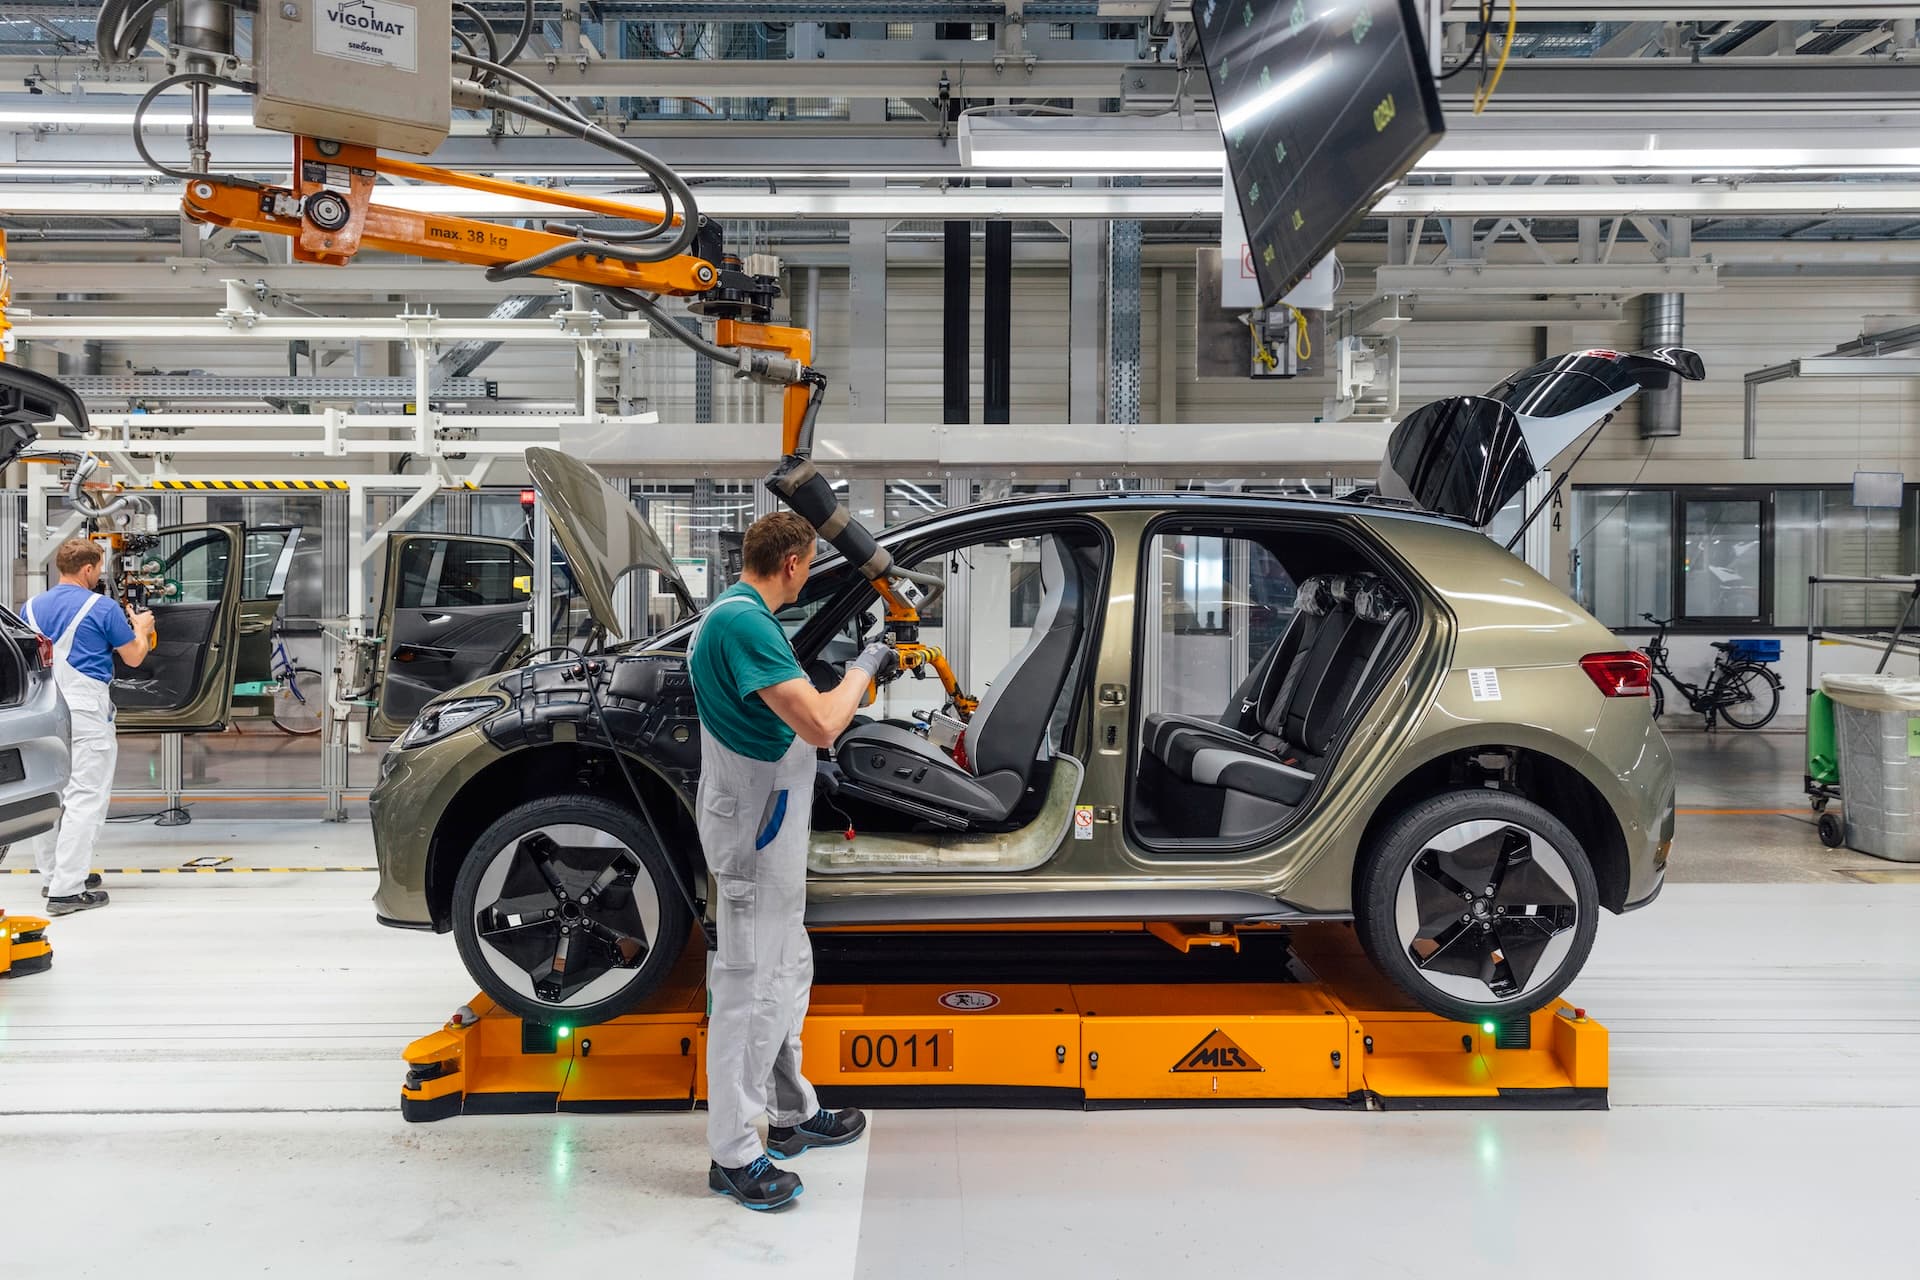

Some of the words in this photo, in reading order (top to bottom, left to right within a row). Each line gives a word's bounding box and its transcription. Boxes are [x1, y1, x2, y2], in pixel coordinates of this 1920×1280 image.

[327, 9, 404, 36] VIGOMAT
[430, 226, 462, 241] max.
[466, 229, 485, 244] 38
[489, 232, 508, 251] kg
[851, 1033, 939, 1068] 0011
[1188, 1047, 1247, 1068] MLR
